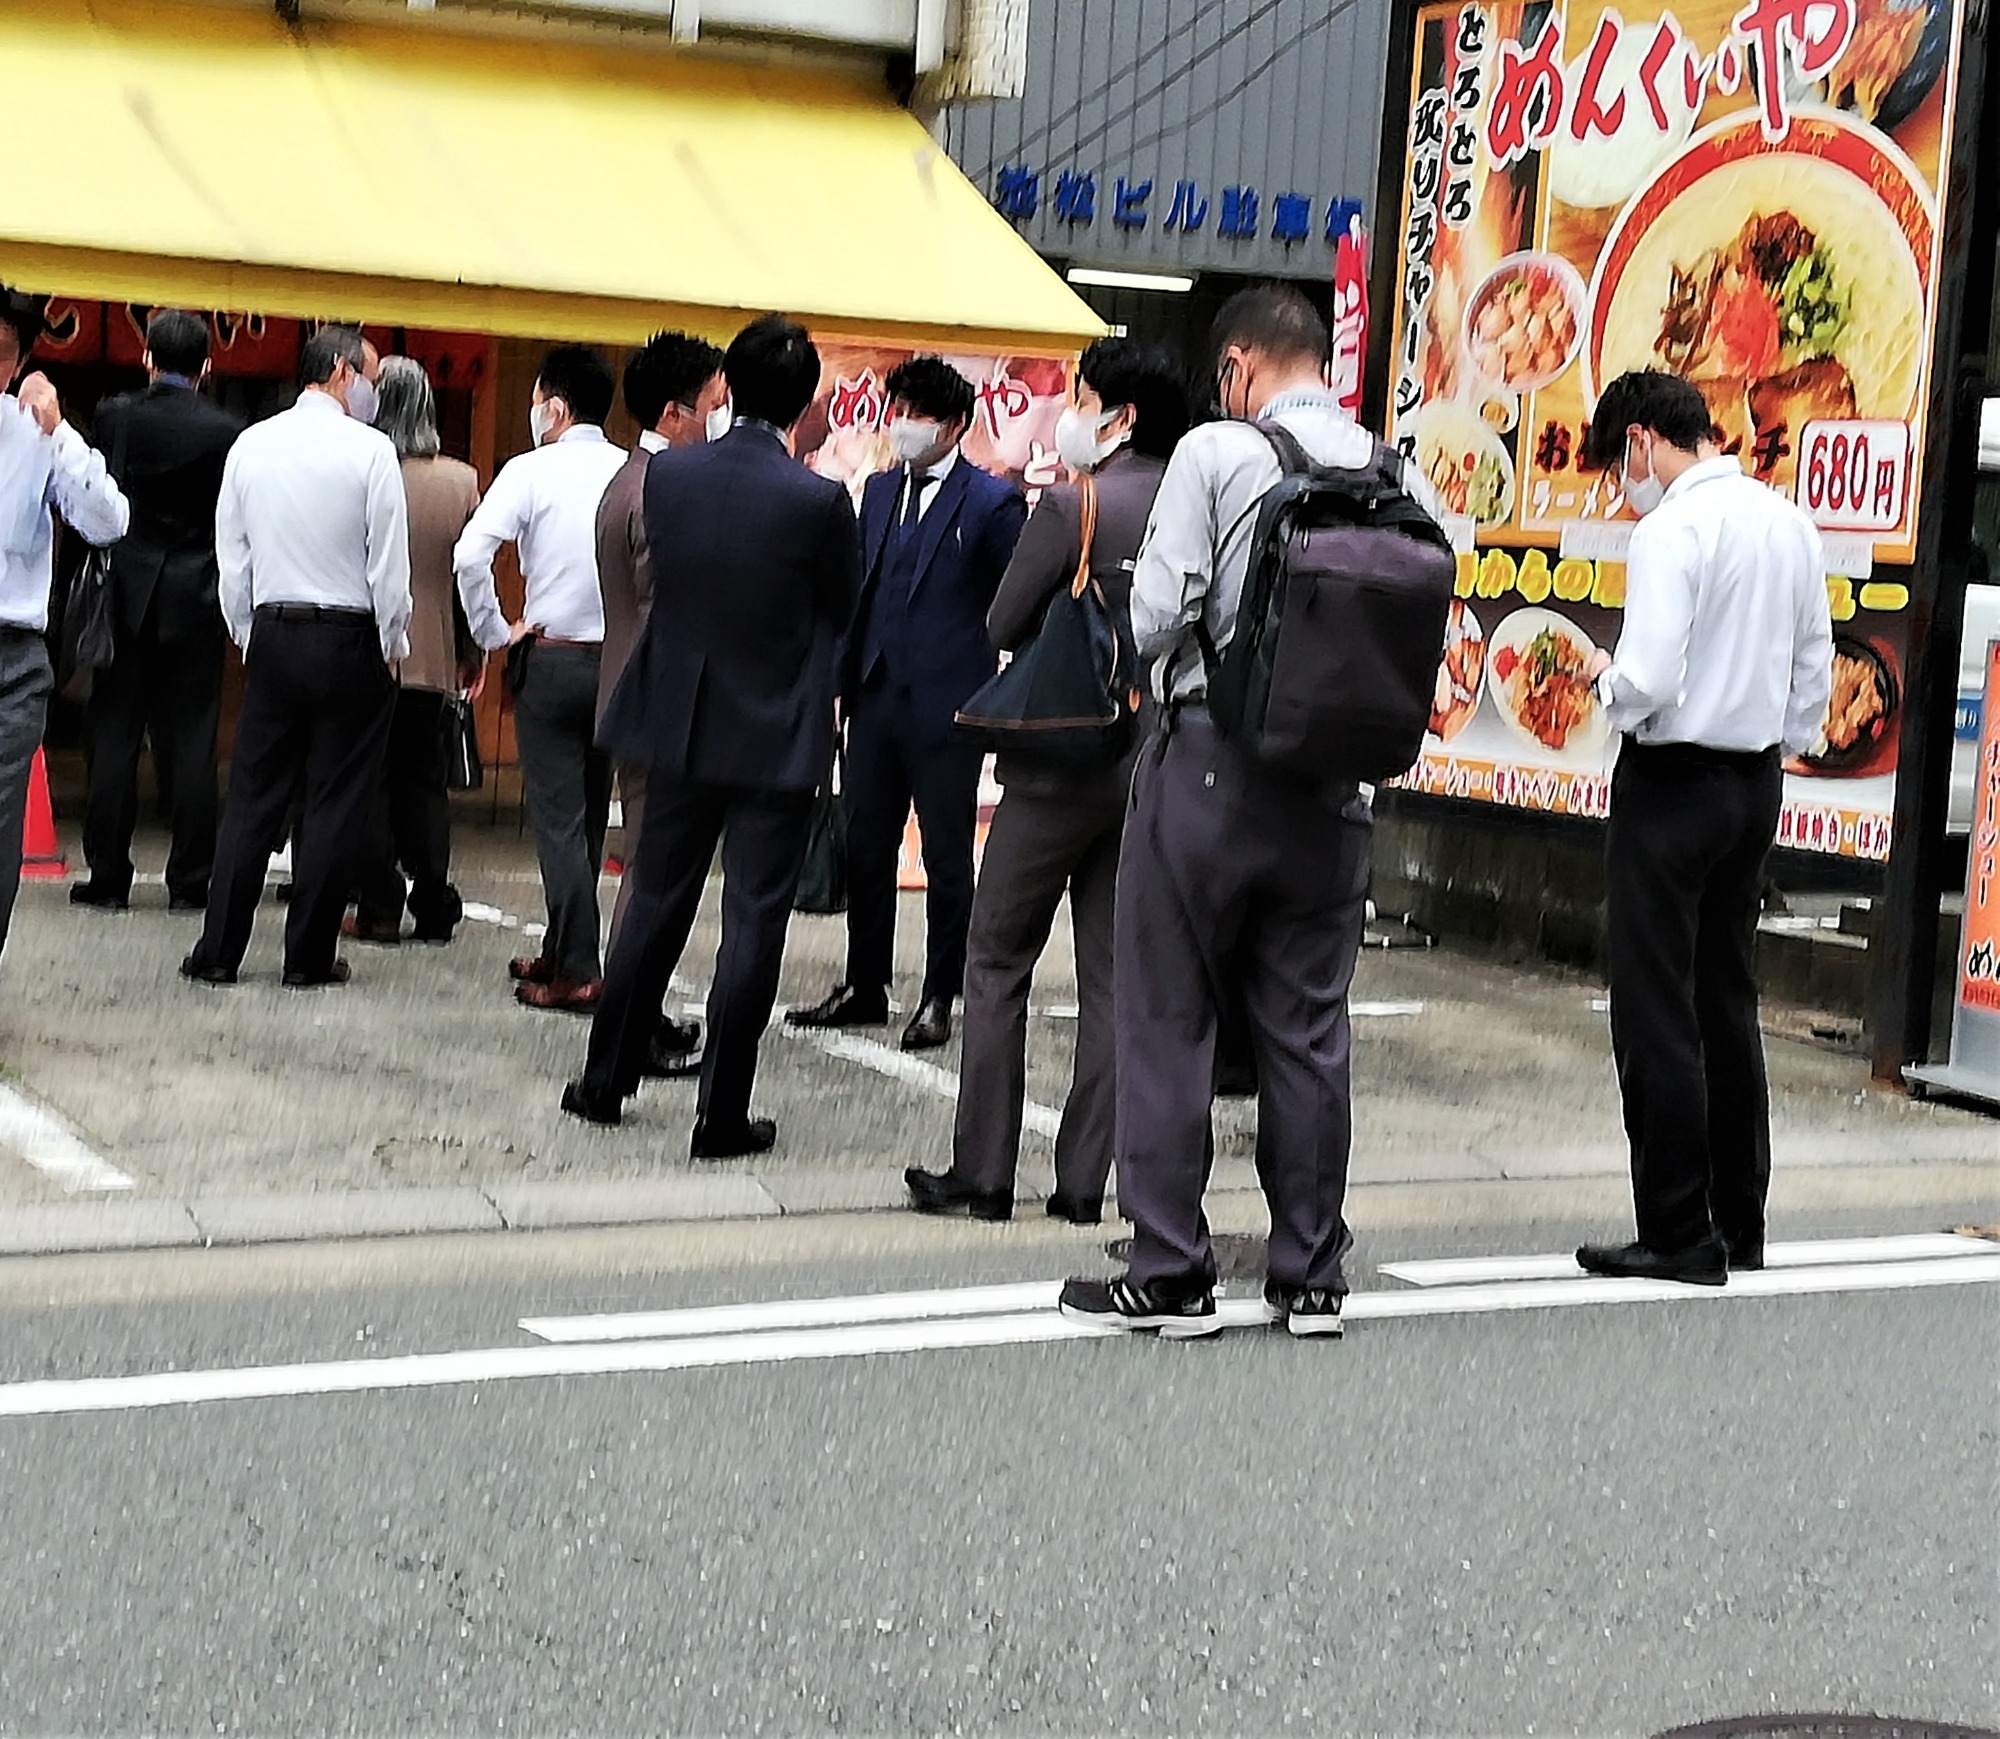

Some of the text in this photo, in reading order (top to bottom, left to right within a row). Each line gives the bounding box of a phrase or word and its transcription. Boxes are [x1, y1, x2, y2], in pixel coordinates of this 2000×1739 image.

[1442, 5, 1486, 226] とろとろ
[1486, 0, 1853, 164] めんくいや
[1807, 432, 1896, 520] 680円
